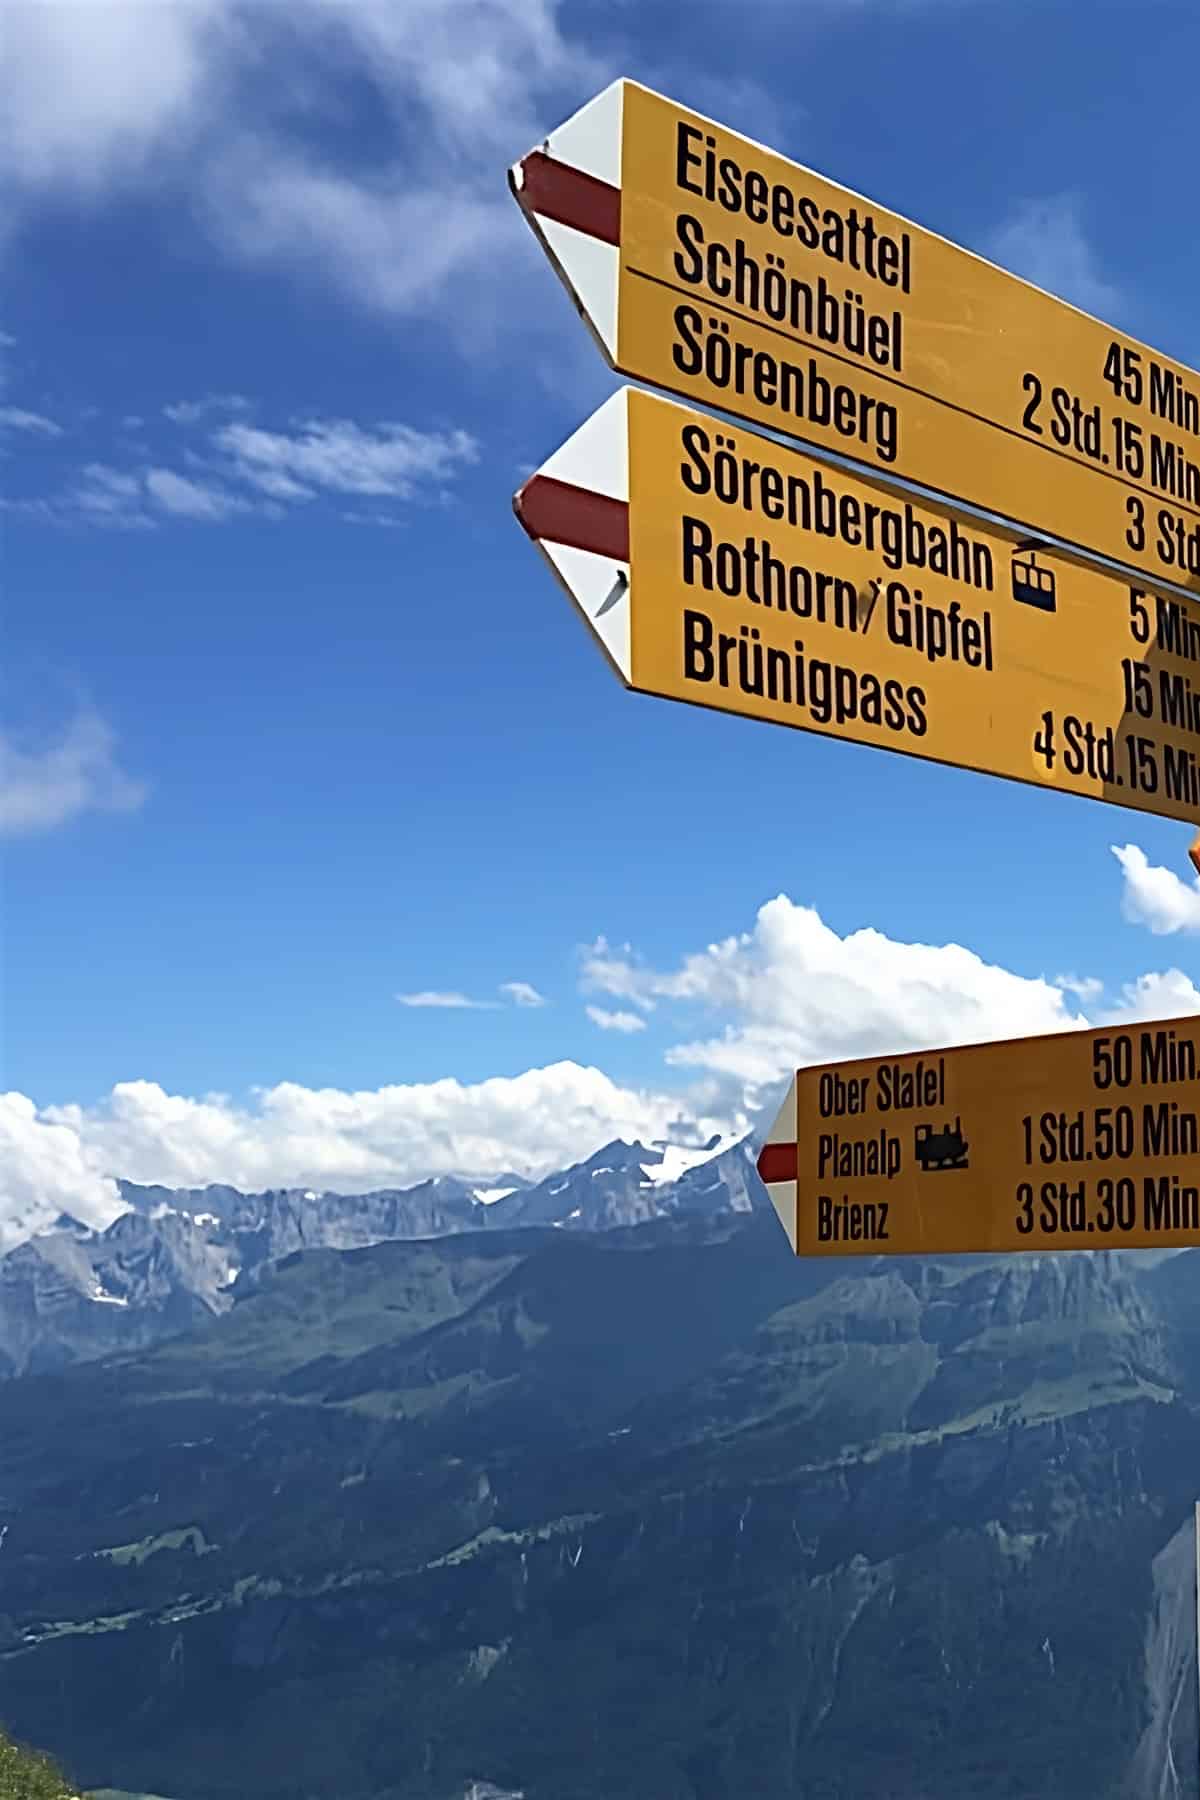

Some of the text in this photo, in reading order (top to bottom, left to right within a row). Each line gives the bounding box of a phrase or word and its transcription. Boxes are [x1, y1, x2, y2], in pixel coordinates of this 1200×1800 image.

[676, 121, 911, 295] Eiseesattel
[673, 214, 902, 372] Schönbüel
[672, 304, 898, 463] Sörenberg
[1103, 341, 1144, 406] 45
[1022, 373, 1043, 435] 2
[680, 424, 994, 592] Sörenbergbahn
[1126, 495, 1146, 552] 3
[1130, 587, 1150, 644] 5
[682, 608, 927, 737] Brünigpass
[1120, 658, 1154, 719] 15
[1033, 710, 1056, 770] 4
[1093, 1035, 1132, 1089] 50
[818, 1072, 870, 1119] Ober
[817, 1127, 901, 1180] Planalp
[1022, 1115, 1032, 1165] 1
[817, 1194, 889, 1242] Brienz
[1015, 1182, 1034, 1234] 3
